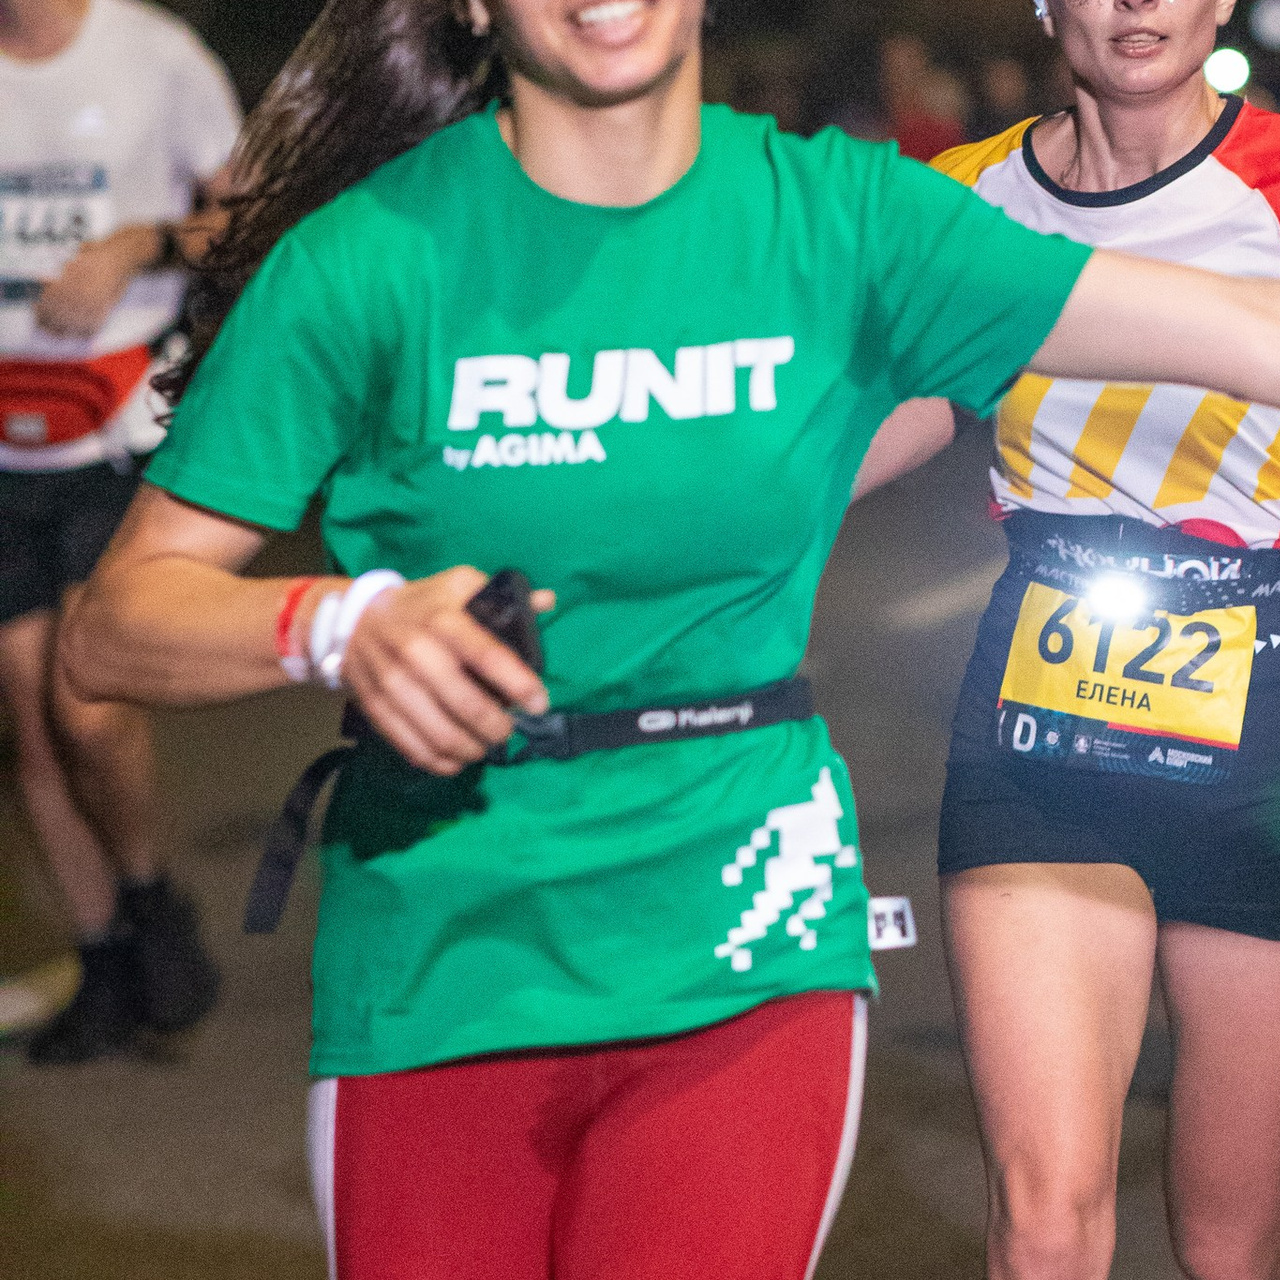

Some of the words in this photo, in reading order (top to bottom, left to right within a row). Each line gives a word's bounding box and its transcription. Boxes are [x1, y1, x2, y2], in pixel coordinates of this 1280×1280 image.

[447, 335, 796, 431] RUNIT
[471, 428, 608, 469] AGIMA
[1037, 597, 1222, 694] 6122
[1075, 679, 1152, 712] ЕЛЕНА
[1012, 712, 1038, 752] D
